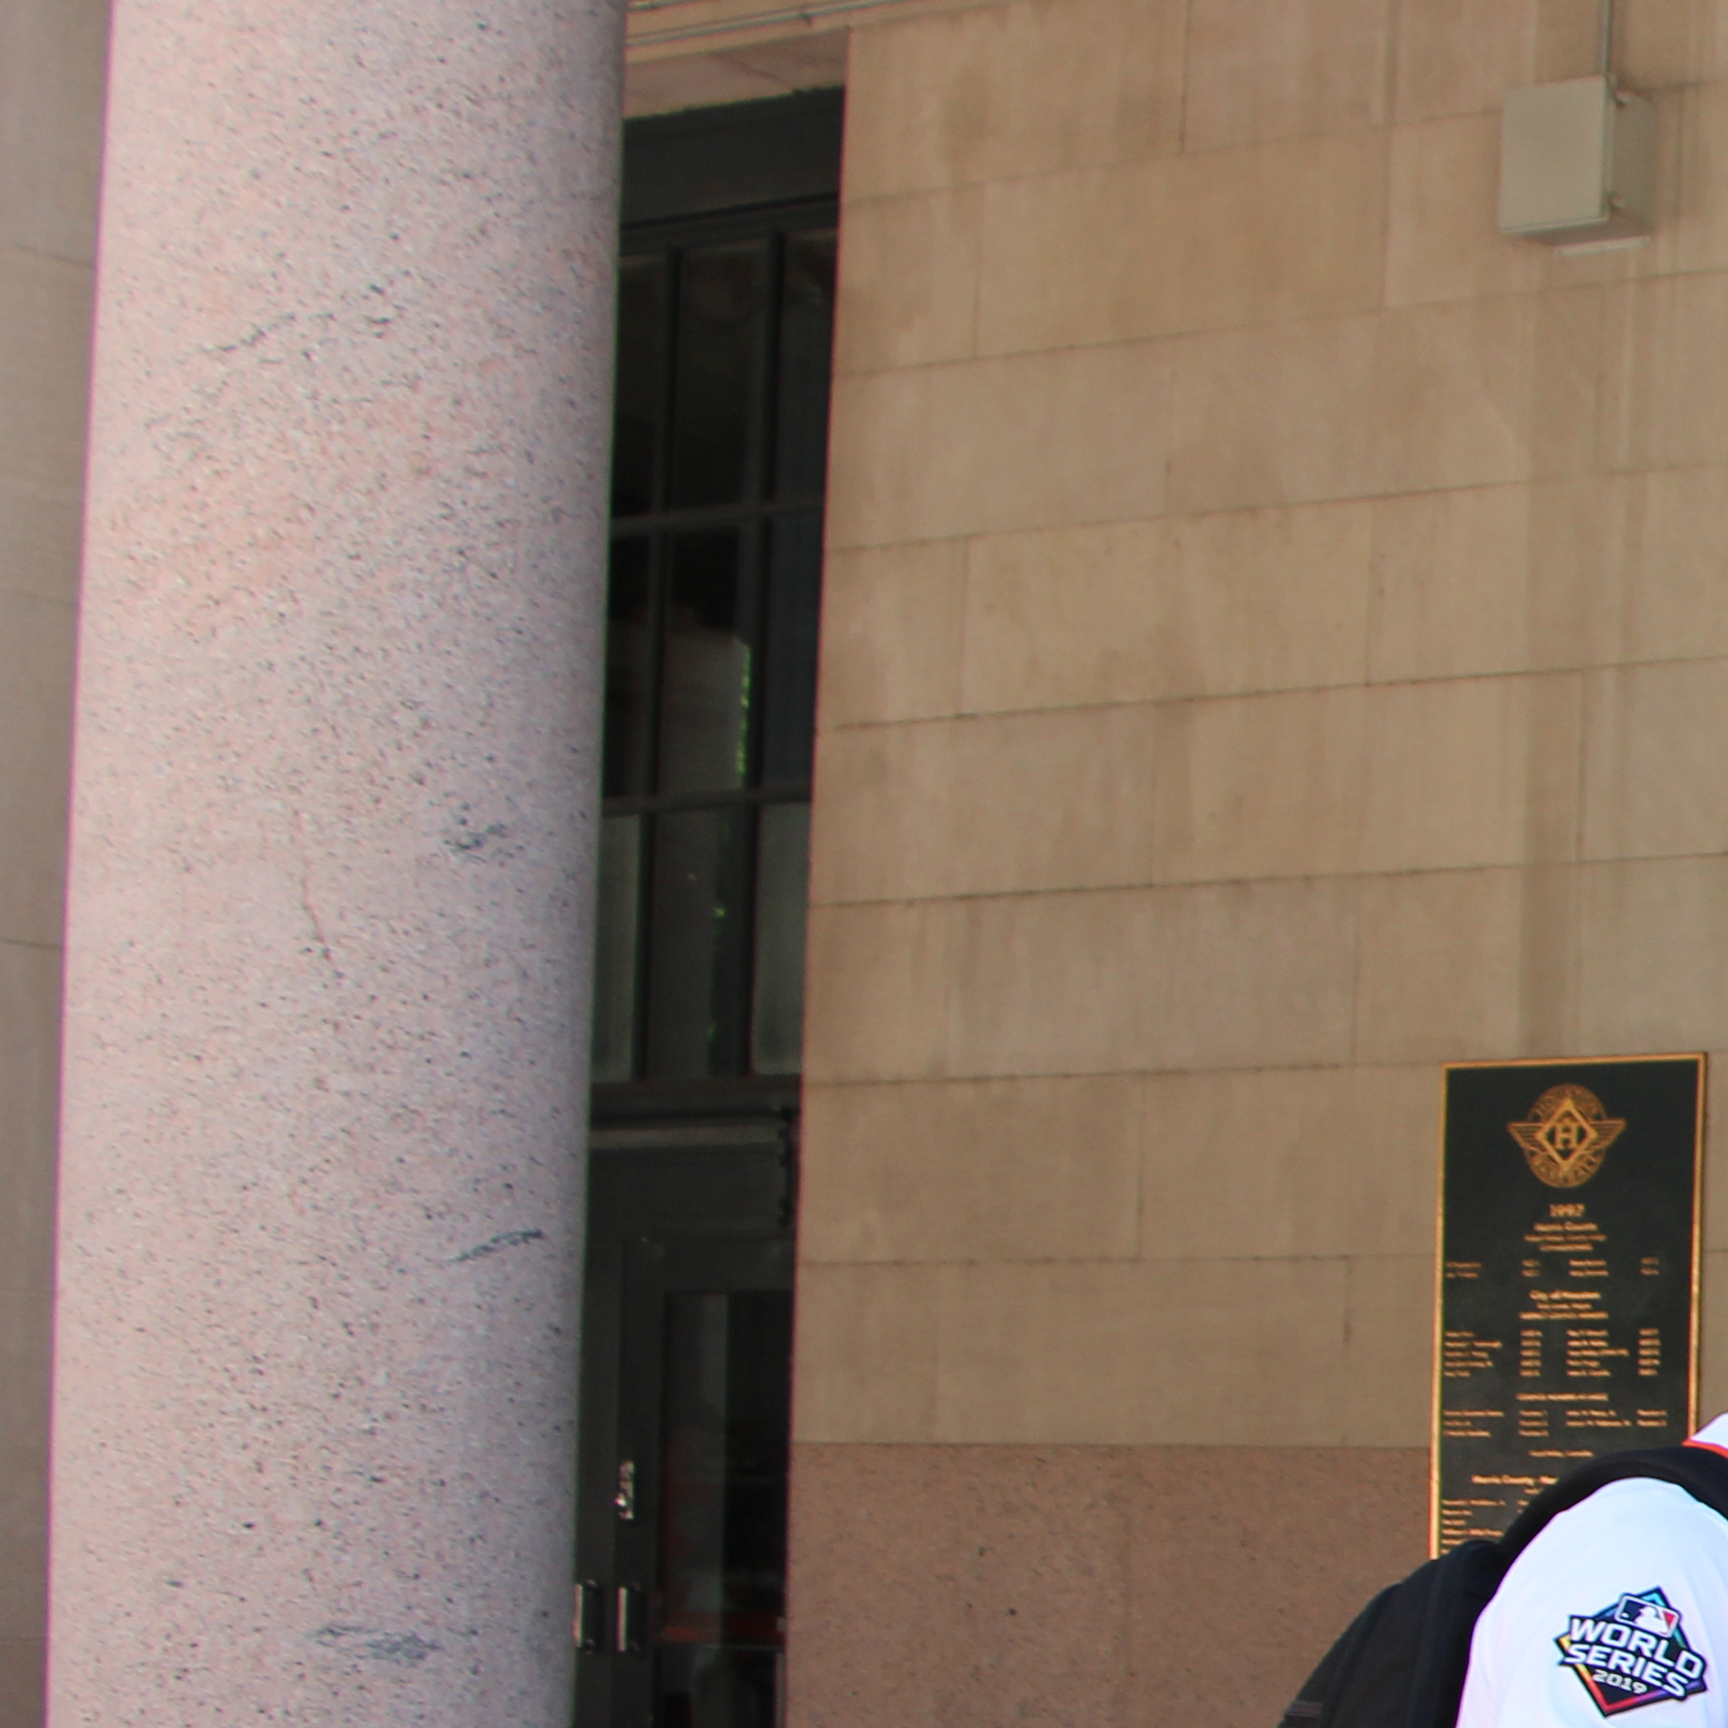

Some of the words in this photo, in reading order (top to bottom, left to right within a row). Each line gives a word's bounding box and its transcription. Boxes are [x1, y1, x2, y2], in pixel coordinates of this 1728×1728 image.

[1564, 1643, 1688, 1698] SERIES
[1568, 1617, 1704, 1680] WORLD
[1592, 1668, 1648, 1694] 2019
